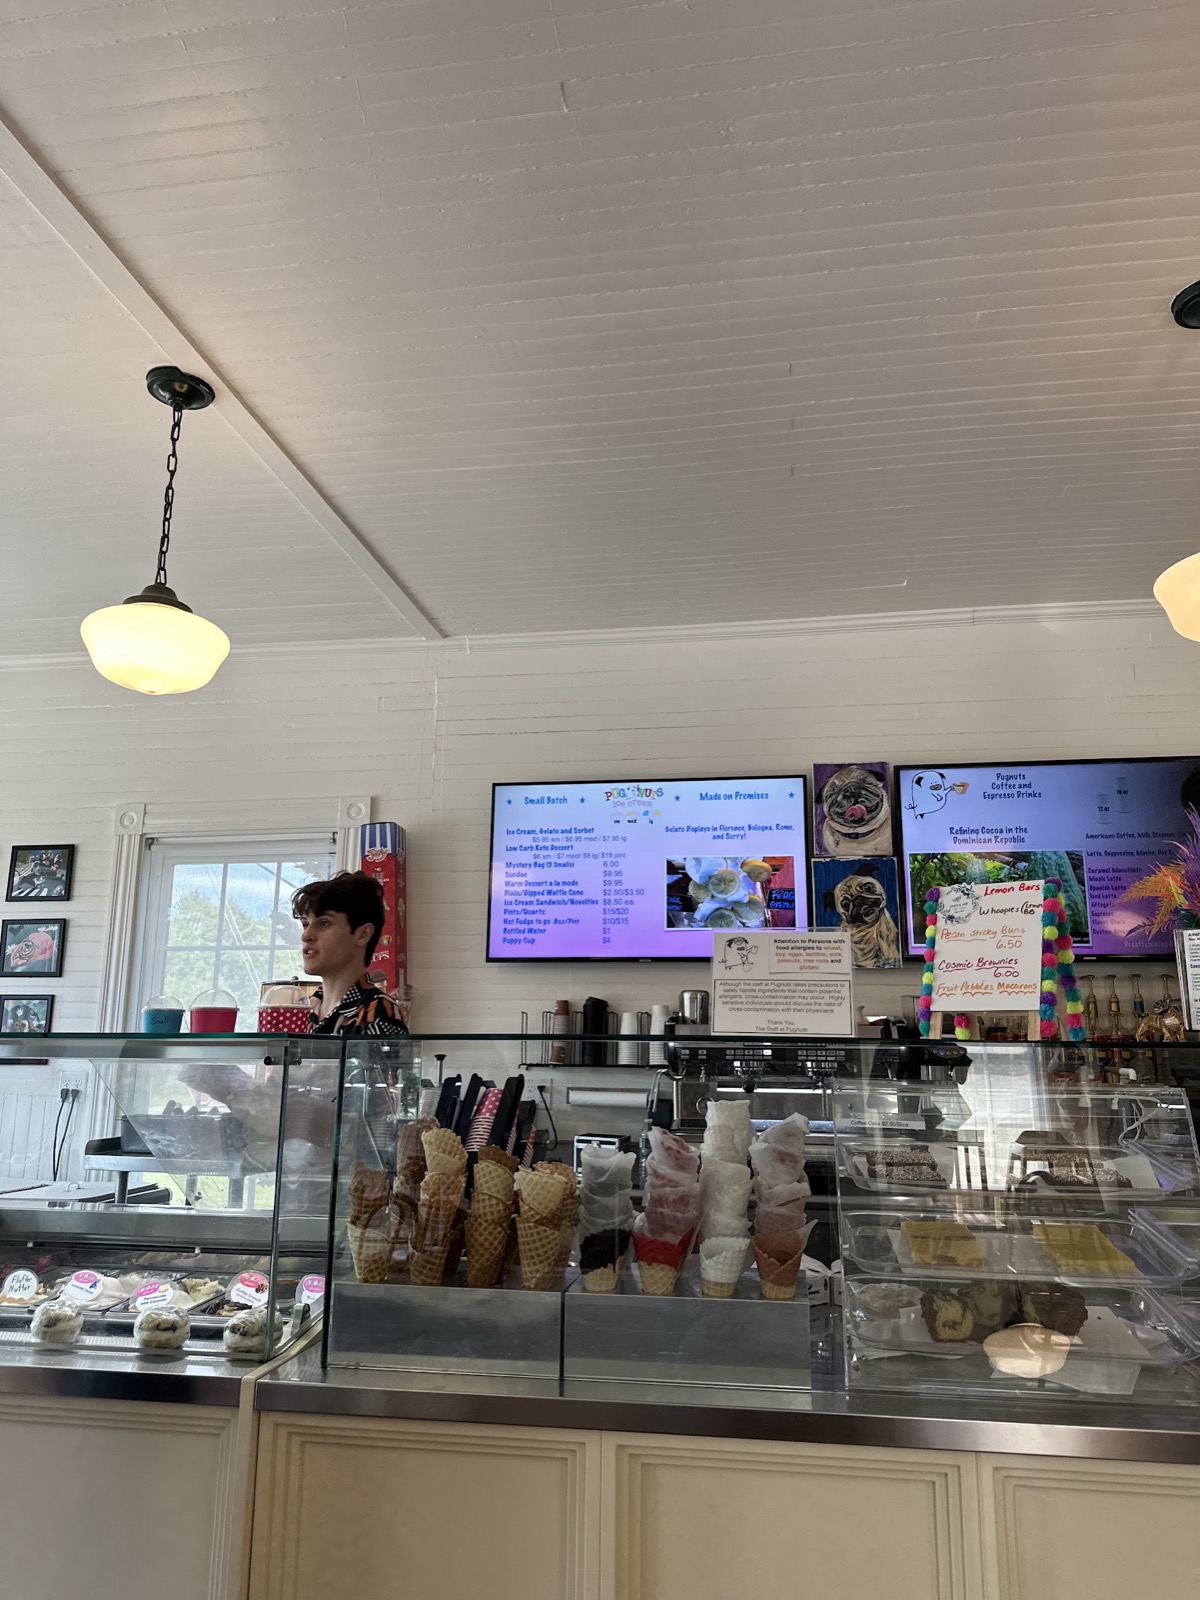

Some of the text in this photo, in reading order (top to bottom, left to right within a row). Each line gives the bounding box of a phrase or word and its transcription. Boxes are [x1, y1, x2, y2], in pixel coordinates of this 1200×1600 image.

[996, 773, 1025, 781] Pugnuts
[547, 796, 567, 804] Batch
[983, 790, 1041, 800] Espresso Drinks
[950, 827, 979, 835] Refining
[994, 836, 1025, 845] Republic
[984, 886, 1014, 896] Lemon
[980, 905, 1019, 915] Whoopies
[941, 926, 1025, 939] Pecan Buns
[996, 940, 1022, 949] 6.50
[938, 958, 1018, 970] Cosmic Brownies
[994, 968, 1020, 978] 6.00
[936, 983, 959, 995] Fruit
[961, 982, 993, 990] Pebbles
